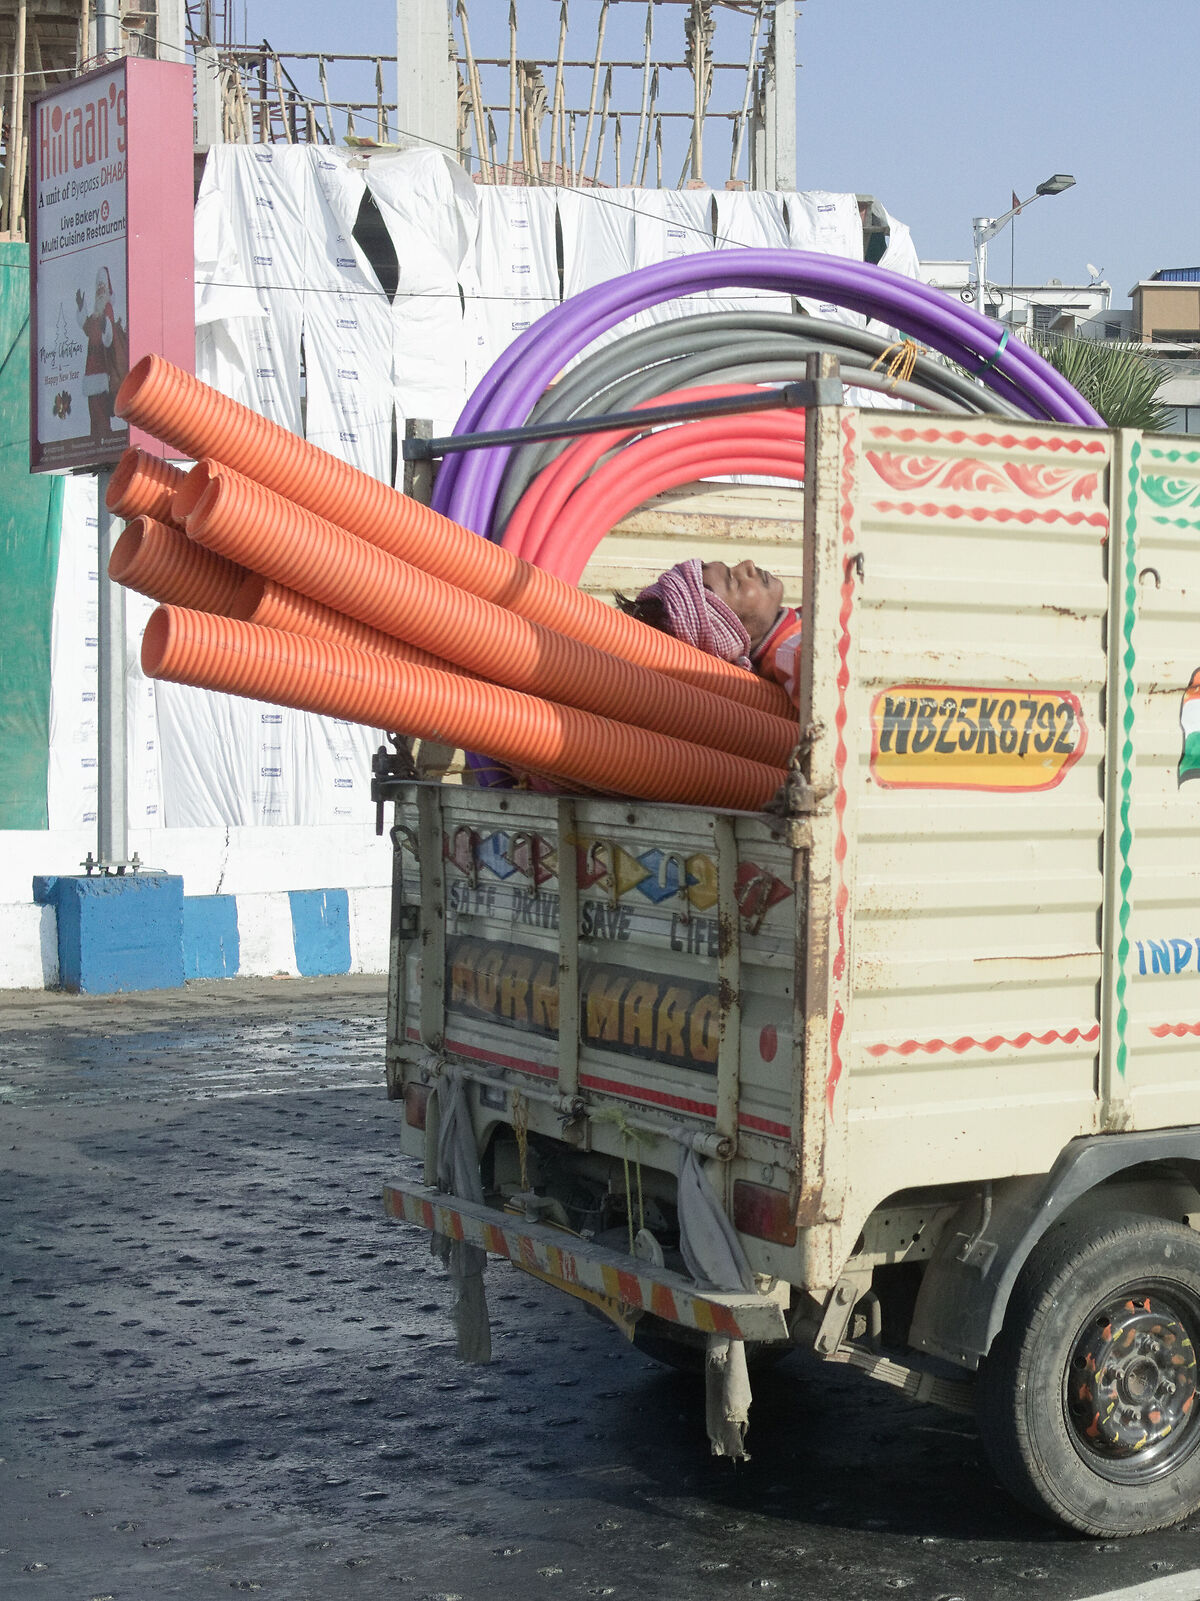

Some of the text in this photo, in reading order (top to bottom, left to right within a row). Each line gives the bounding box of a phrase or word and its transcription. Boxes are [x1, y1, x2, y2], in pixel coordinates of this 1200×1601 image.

[38, 191, 44, 208] A
[46, 187, 60, 206] unit
[61, 180, 70, 200] of
[71, 175, 99, 200] Byepass
[41, 216, 126, 254] Multi Cuisine Restaurant
[60, 213, 75, 230] Live
[75, 207, 100, 228] Bakery
[879, 696, 1076, 756] WB25K8792
[450, 879, 498, 918] SAFE
[581, 900, 635, 942] SAVE
[671, 912, 719, 958] LIFE
